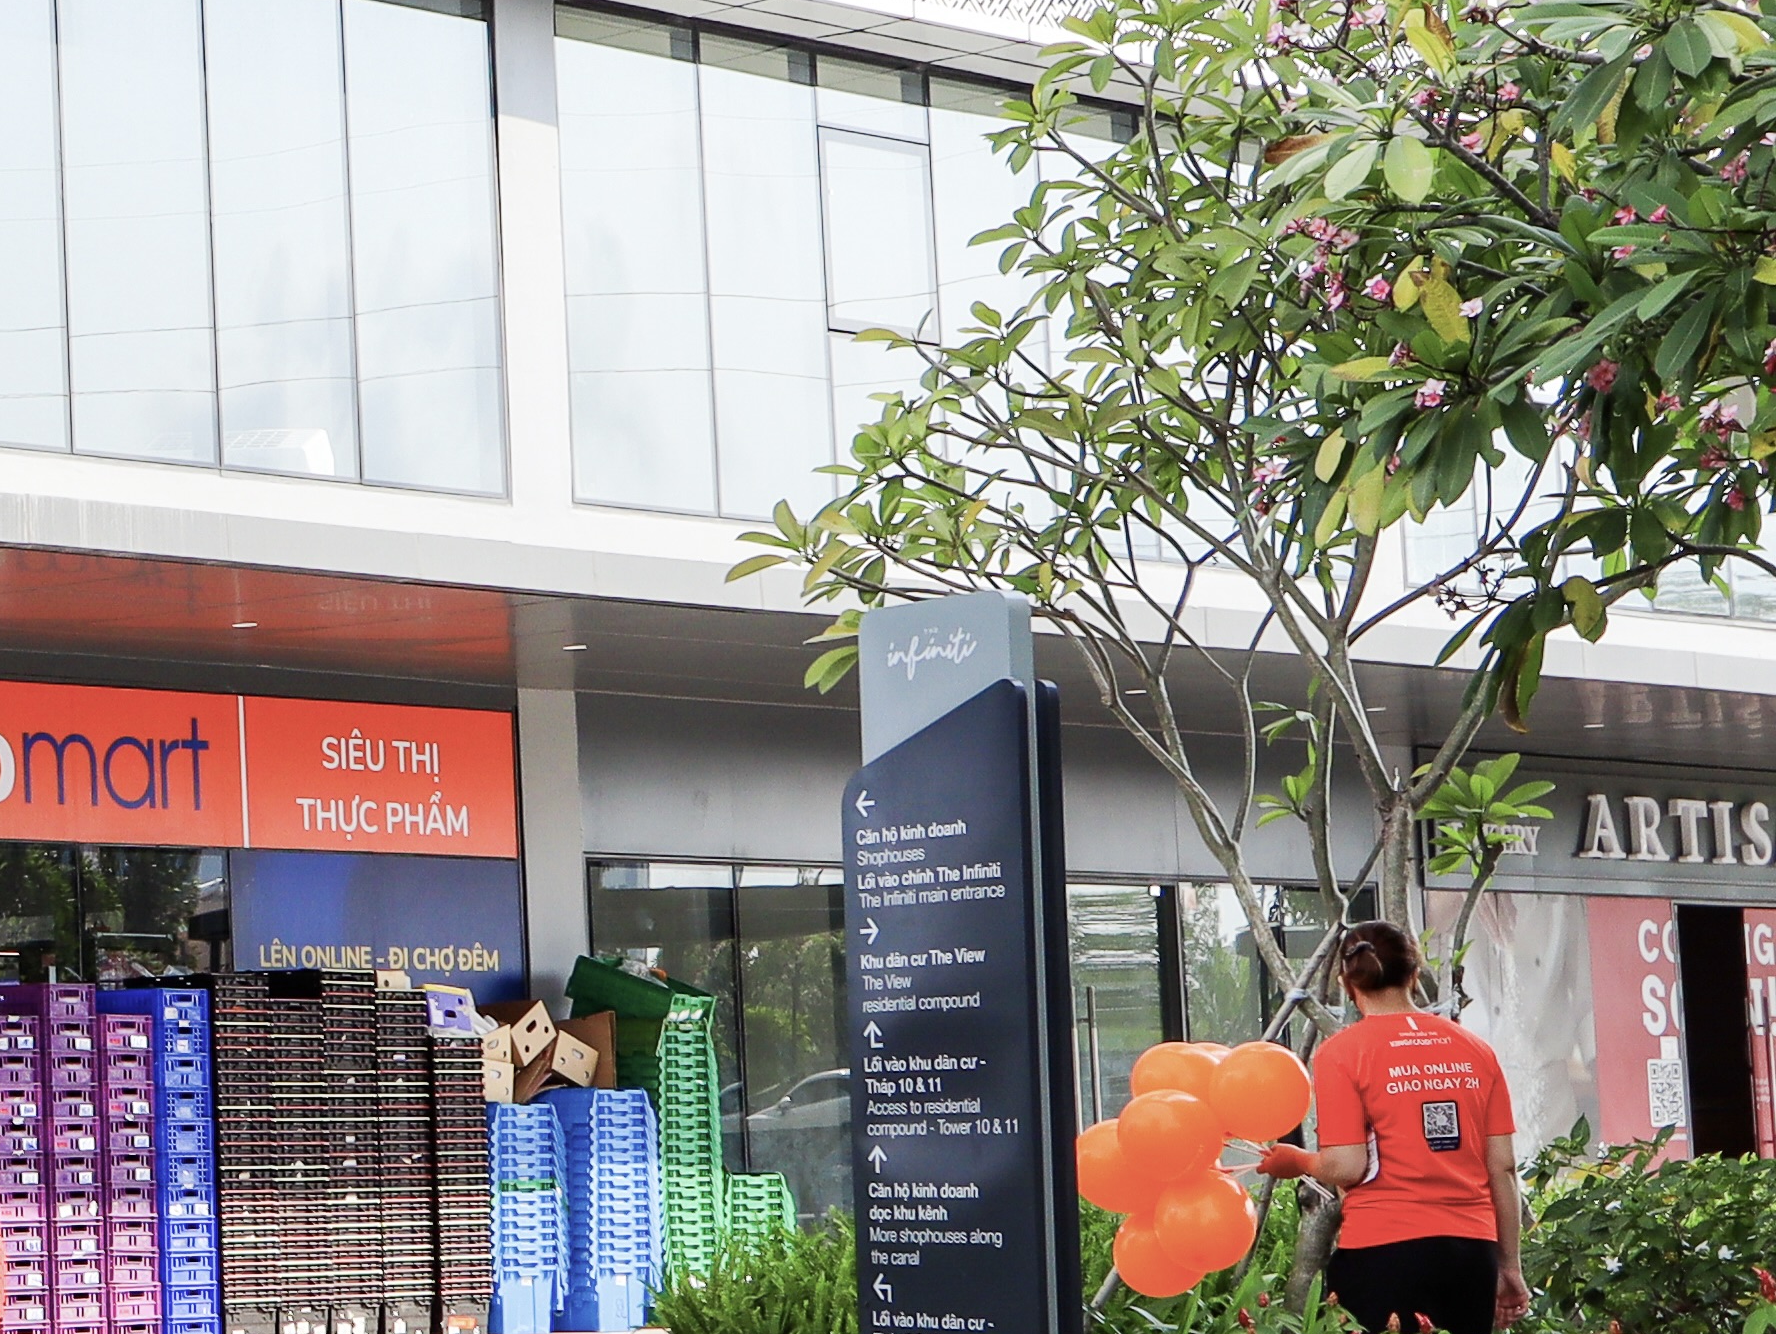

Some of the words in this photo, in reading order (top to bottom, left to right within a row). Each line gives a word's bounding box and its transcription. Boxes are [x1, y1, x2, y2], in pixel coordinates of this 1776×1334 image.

[321, 728, 385, 772] SIÊU
[391, 740, 440, 783] THỊ
[296, 795, 378, 841] THỰC
[385, 790, 469, 837] PHẨM
[856, 829, 880, 845] Căn
[882, 827, 898, 845] hộ
[900, 825, 926, 841] kinh
[928, 819, 967, 838] doanh
[1579, 793, 1773, 866] ARTIS
[857, 848, 925, 867] Shophouses
[877, 871, 899, 887] vào
[901, 867, 934, 885] chính
[937, 867, 960, 882] The
[963, 862, 1001, 880] Infiniti
[859, 893, 881, 909] The
[883, 889, 916, 907] Infiniti
[919, 887, 947, 903] main
[951, 885, 1005, 901] entrance
[259, 938, 297, 968] LÊN
[301, 944, 372, 969] ONLINE
[388, 947, 408, 969] ĐI
[413, 944, 454, 977] CHỢ
[457, 942, 499, 972] ĐÊM
[860, 954, 884, 969] Khu
[886, 952, 908, 968] dân
[910, 954, 928, 966] cư
[929, 950, 952, 965] The
[954, 948, 985, 963] View
[862, 975, 883, 990] The
[885, 974, 912, 989] View
[862, 995, 916, 1013] residential
[919, 992, 980, 1011] compound
[884, 1056, 906, 1072] vào
[909, 1056, 931, 1071] khu
[934, 1054, 958, 1070] dân
[960, 1057, 977, 1069] cư
[1388, 1065, 1420, 1078] MUA
[1424, 1062, 1473, 1075] ONLINE
[865, 1078, 896, 1097] Tháp
[898, 1078, 913, 1093] 10
[916, 1077, 925, 1093] &
[928, 1077, 941, 1092] 11
[1386, 1079, 1422, 1094] GIAO
[1424, 1077, 1461, 1091] NGAY
[1465, 1077, 1479, 1089] 2H
[867, 1100, 907, 1115] Access
[910, 1100, 921, 1114] to
[924, 1097, 981, 1114] residential
[867, 1120, 927, 1138] compound
[937, 1119, 972, 1135] Tower
[976, 1119, 990, 1134] 10
[993, 1118, 1002, 1134] &
[1005, 1118, 1018, 1134] 11
[868, 1182, 892, 1199] Căn
[894, 1182, 910, 1201] hộ
[912, 1182, 938, 1199] kinh
[940, 1182, 979, 1199] doanh
[869, 1205, 892, 1223] dọc
[894, 1205, 916, 1220] khu
[918, 1204, 948, 1221] kênh
[869, 1227, 897, 1243] More
[900, 1227, 968, 1246] shophouses
[970, 1228, 1003, 1248] along
[871, 1249, 888, 1265] the
[891, 1250, 920, 1265] canal
[892, 1311, 914, 1328] vào
[917, 1312, 939, 1328] khu
[941, 1313, 965, 1330] dân
[968, 1318, 985, 1331] cư
